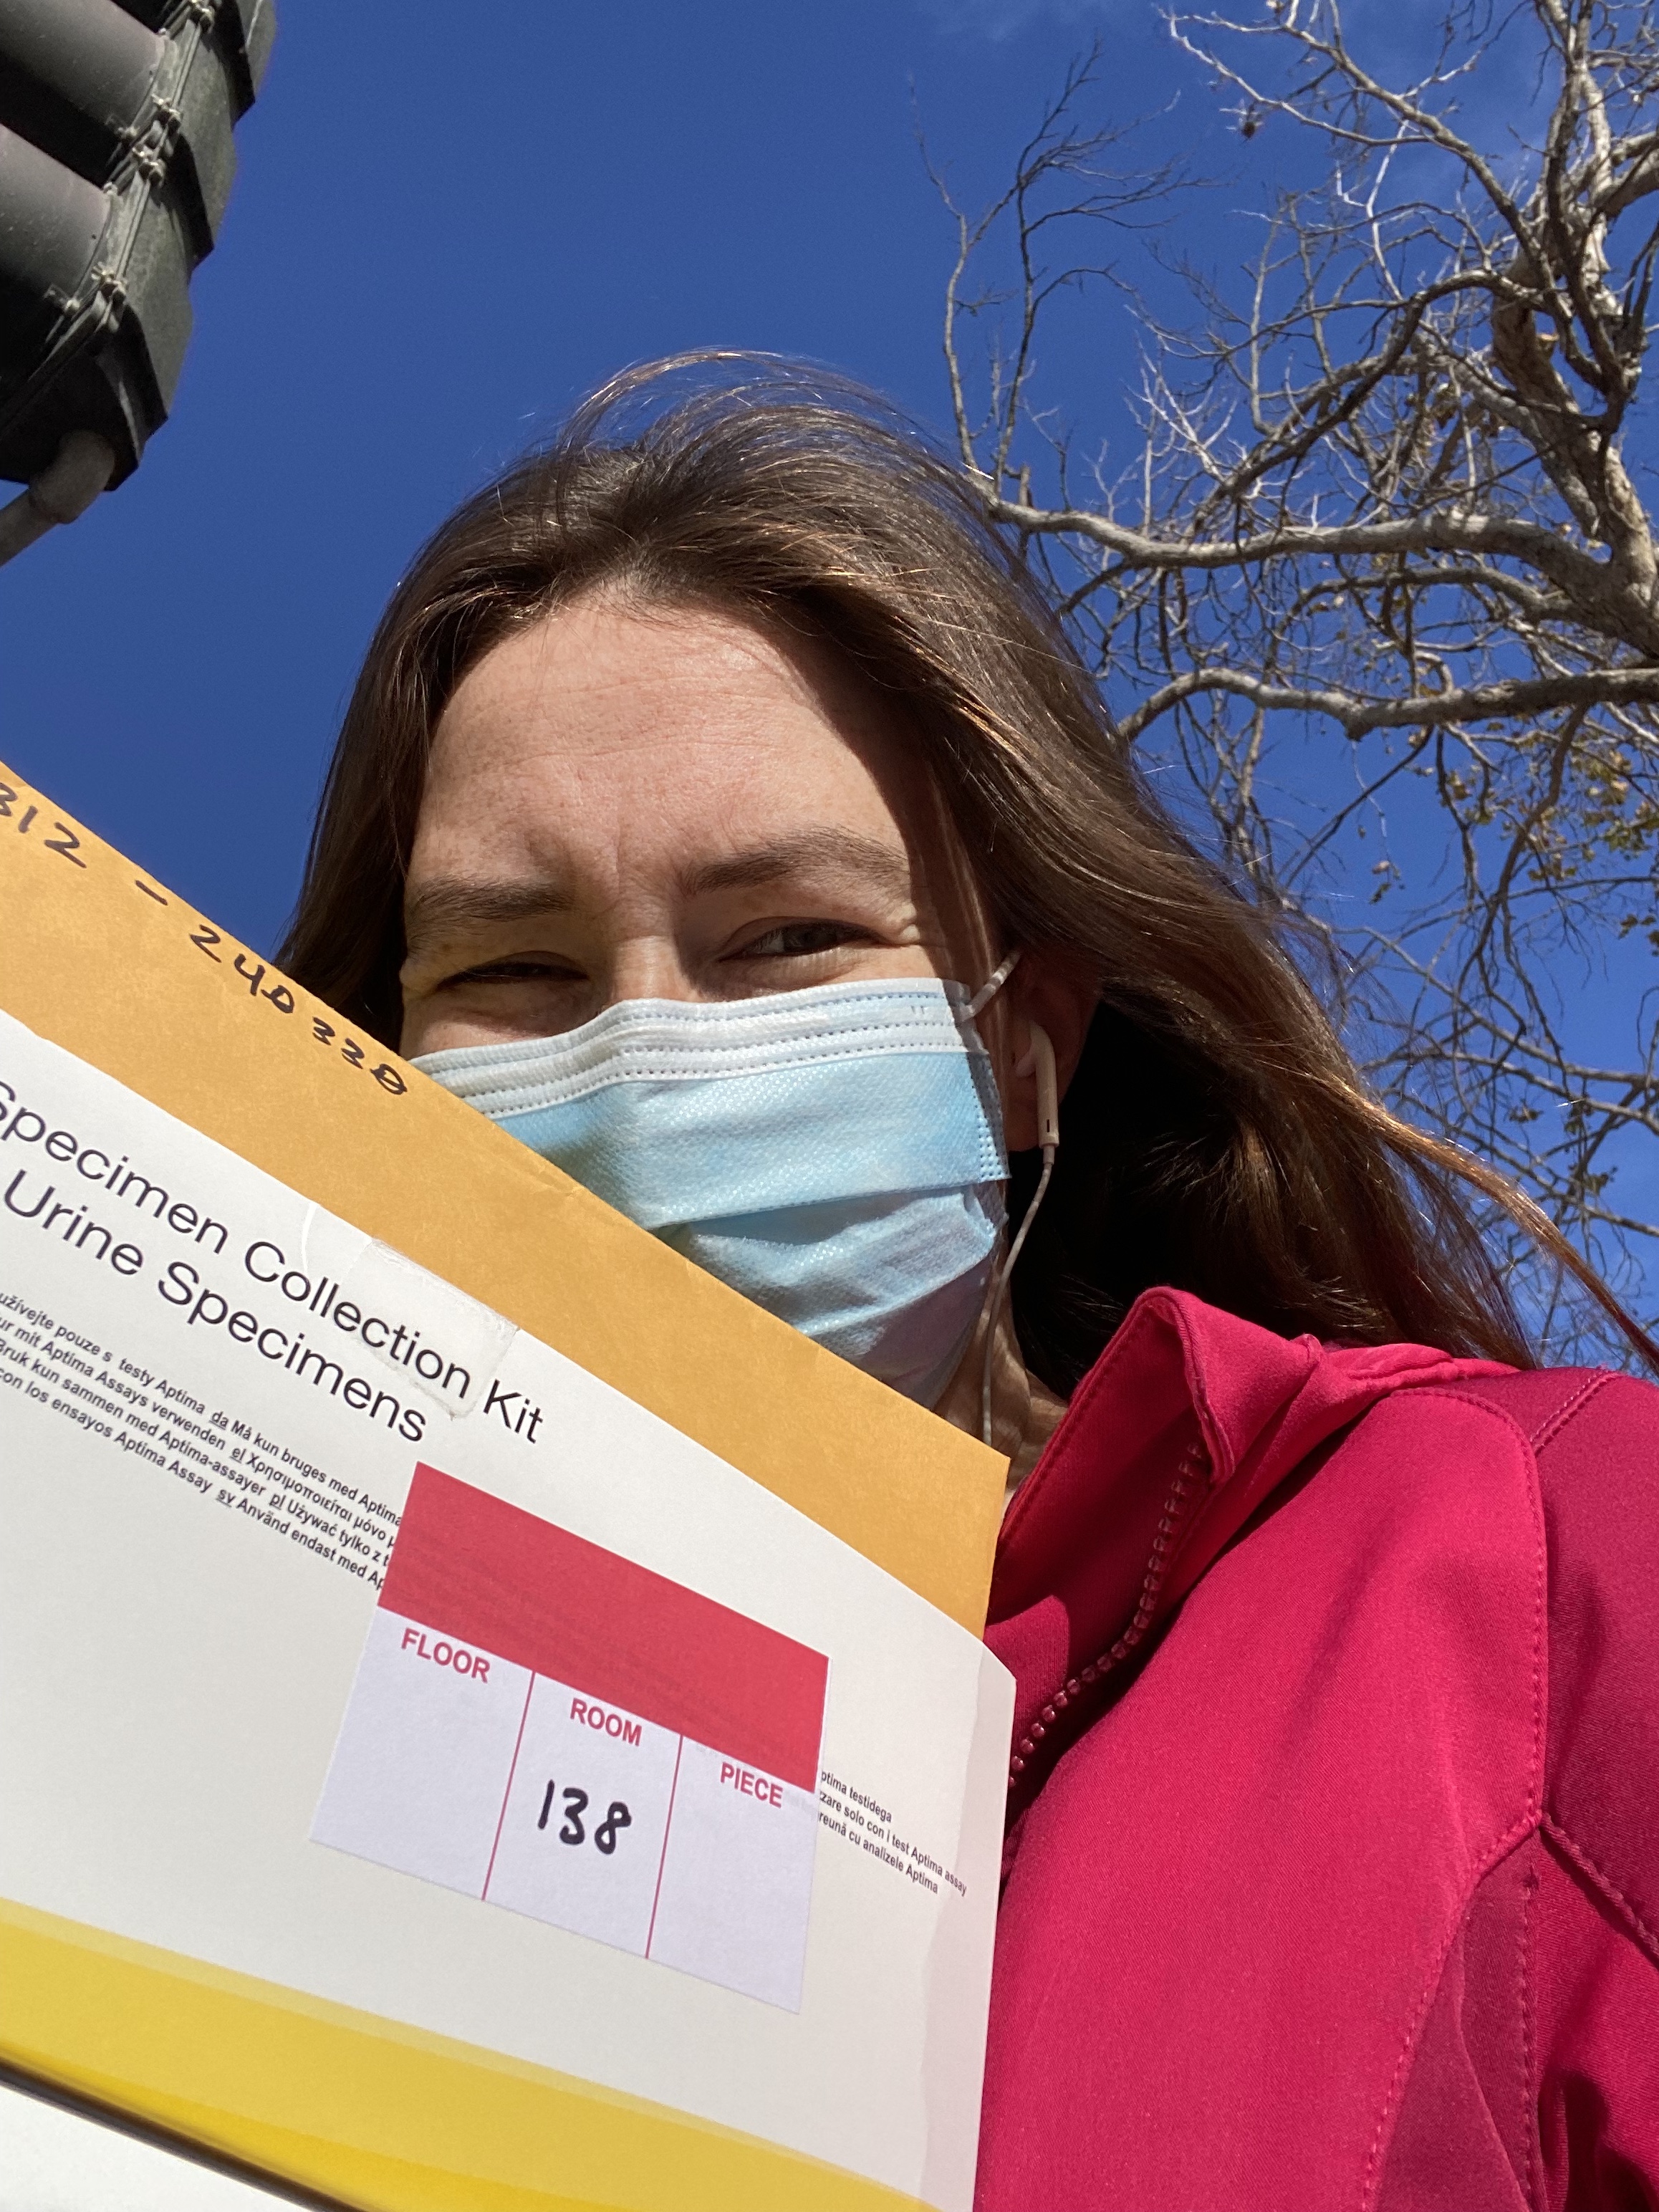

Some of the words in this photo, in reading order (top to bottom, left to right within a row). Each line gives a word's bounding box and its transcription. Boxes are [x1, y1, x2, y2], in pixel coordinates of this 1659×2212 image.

[4, 1169, 143, 1275] Urine
[158, 1261, 425, 1441] Specimens
[245, 1241, 471, 1399] Collection
[484, 1379, 543, 1444] Kit
[14, 1328, 41, 1347] mit
[40, 1341, 94, 1377] Aptima
[95, 1371, 148, 1407] Assays
[152, 1402, 226, 1450] verwenden
[229, 1448, 246, 1463] el
[352, 1516, 386, 1540] μόνο
[54, 1326, 100, 1355] pouze
[102, 1352, 112, 1362] s
[119, 1359, 155, 1387] testy
[155, 1380, 205, 1414] Aptima
[208, 1411, 229, 1430] da
[231, 1420, 252, 1441] Må
[253, 1433, 279, 1456] kun
[281, 1448, 327, 1483] bruges
[328, 1478, 358, 1501] med
[25, 1381, 49, 1403] los
[52, 1399, 113, 1437] ensayos
[114, 1431, 166, 1467] Aptima
[167, 1460, 213, 1494] Assay
[216, 1489, 236, 1507] sv
[236, 1498, 291, 1534] Använd
[291, 1530, 337, 1562] endast
[337, 1555, 368, 1578] med
[30, 1359, 60, 1383] kun
[62, 1379, 123, 1418] sammen
[125, 1413, 160, 1437] med
[158, 1430, 266, 1496] Aptima-assayer
[268, 1494, 287, 1510] pl
[287, 1499, 338, 1537] Używać
[339, 1529, 370, 1556] tylko
[372, 1550, 382, 1562] z
[400, 1628, 491, 1683] FLOOR
[570, 1698, 641, 1746] ROOM
[537, 1779, 632, 1855] 138
[720, 1761, 783, 1809] PIECE
[850, 1787, 891, 1822] testidega
[844, 1807, 864, 1826] solo
[867, 1822, 884, 1839] con
[893, 1834, 909, 1855] test
[911, 1847, 942, 1876] Aptima
[945, 1871, 966, 1897] assay
[849, 1831, 860, 1845] cu
[863, 1840, 903, 1871] analizele
[906, 1864, 938, 1894] Aptima
